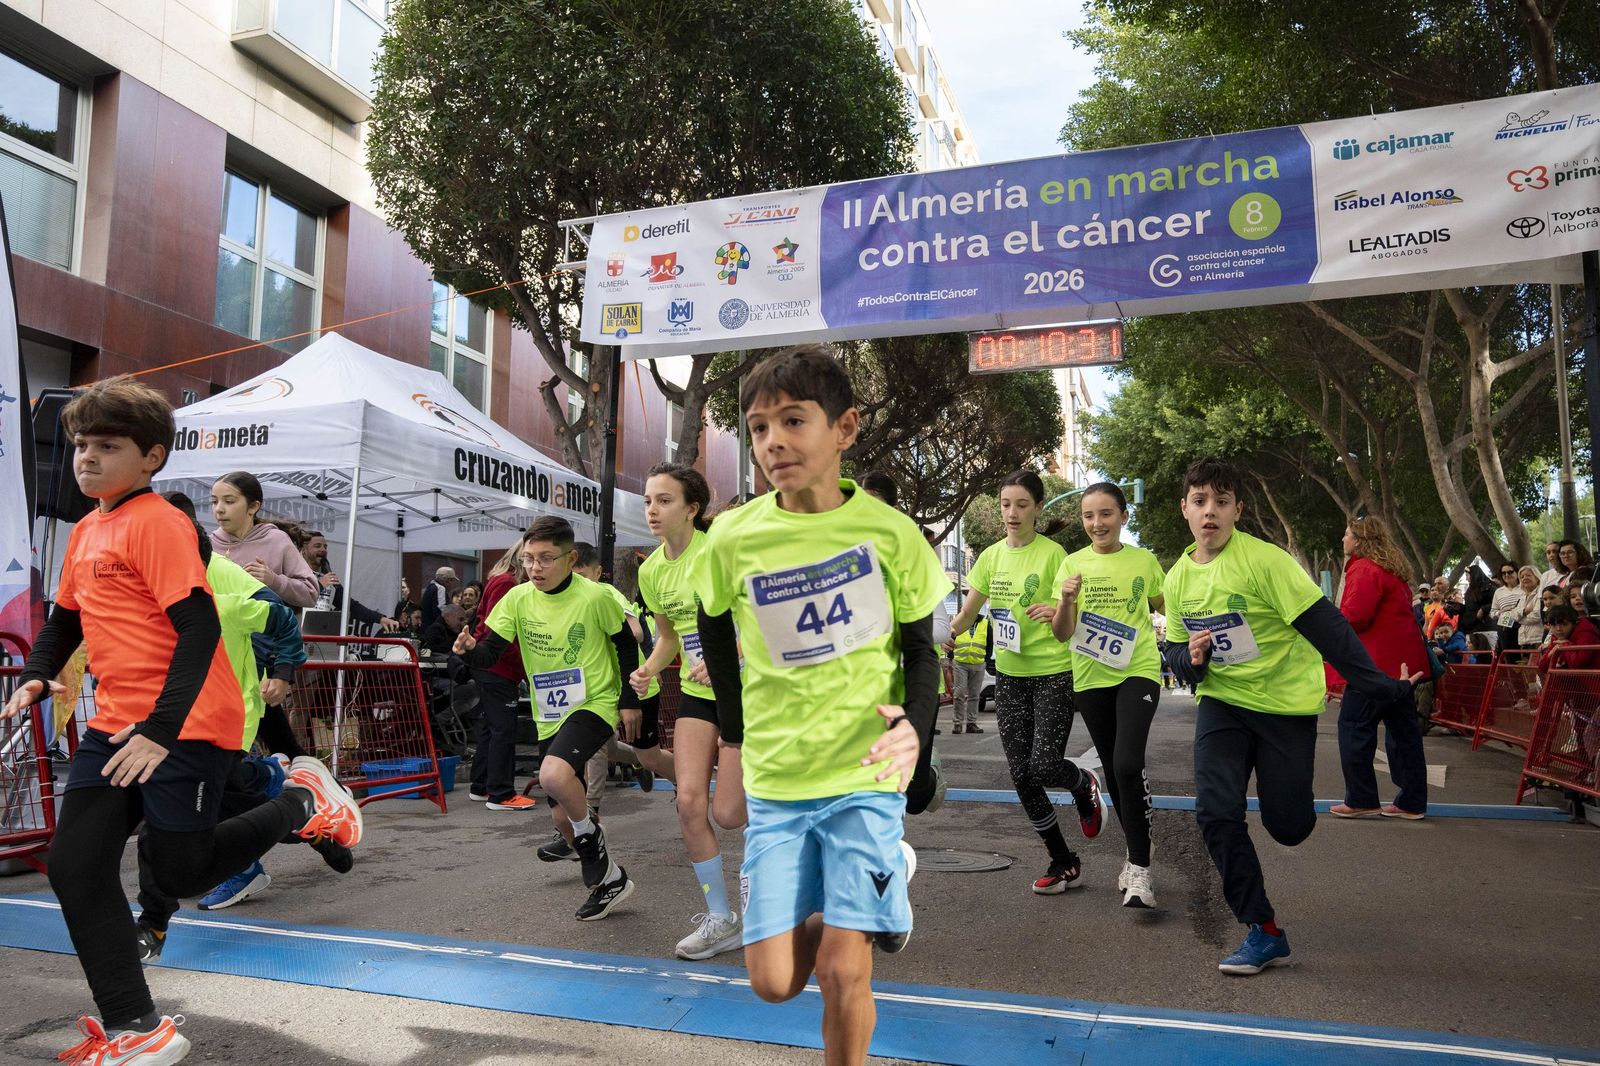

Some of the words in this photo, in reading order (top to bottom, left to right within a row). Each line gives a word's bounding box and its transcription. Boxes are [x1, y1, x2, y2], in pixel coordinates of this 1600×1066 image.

[1494, 123, 1567, 140] MICHELIN
[1365, 130, 1455, 156] cajamar
[843, 199, 861, 229] II
[868, 179, 1028, 225] Almería
[1039, 176, 1091, 204] en
[1107, 151, 1280, 198] marcha
[1334, 193, 1385, 211] Isabel
[1390, 188, 1455, 205] Alonso
[1246, 200, 1264, 225] 8
[1552, 206, 1600, 222] Toyota
[642, 219, 690, 239] deretil
[1553, 218, 1599, 235] Alborá
[858, 232, 990, 271] contra
[1003, 221, 1044, 255] el
[1056, 209, 1212, 250] cáncer
[1348, 228, 1451, 253] LEALTADIS
[1187, 248, 1240, 261] asociación
[1241, 245, 1286, 256] española
[1371, 248, 1428, 260] ABOGADOS
[1189, 262, 1220, 271] contra
[1222, 260, 1231, 268] el
[1232, 257, 1266, 268] cáncer
[1023, 267, 1085, 295] 2026
[1204, 270, 1245, 281] Almería
[750, 300, 810, 312] UNIVERSIDAD
[857, 288, 979, 308] #TodosContraElCáncer
[616, 318, 638, 326] CABRAS
[750, 312, 763, 321] DE
[766, 308, 810, 320] ALMERÍA
[766, 586, 801, 600] contra
[801, 582, 812, 592] el
[814, 571, 849, 590] cáncer
[767, 573, 807, 587] Almería
[796, 592, 853, 635] 44
[998, 623, 1015, 640] 719
[1085, 628, 1123, 655] 716
[547, 689, 569, 708] 42
